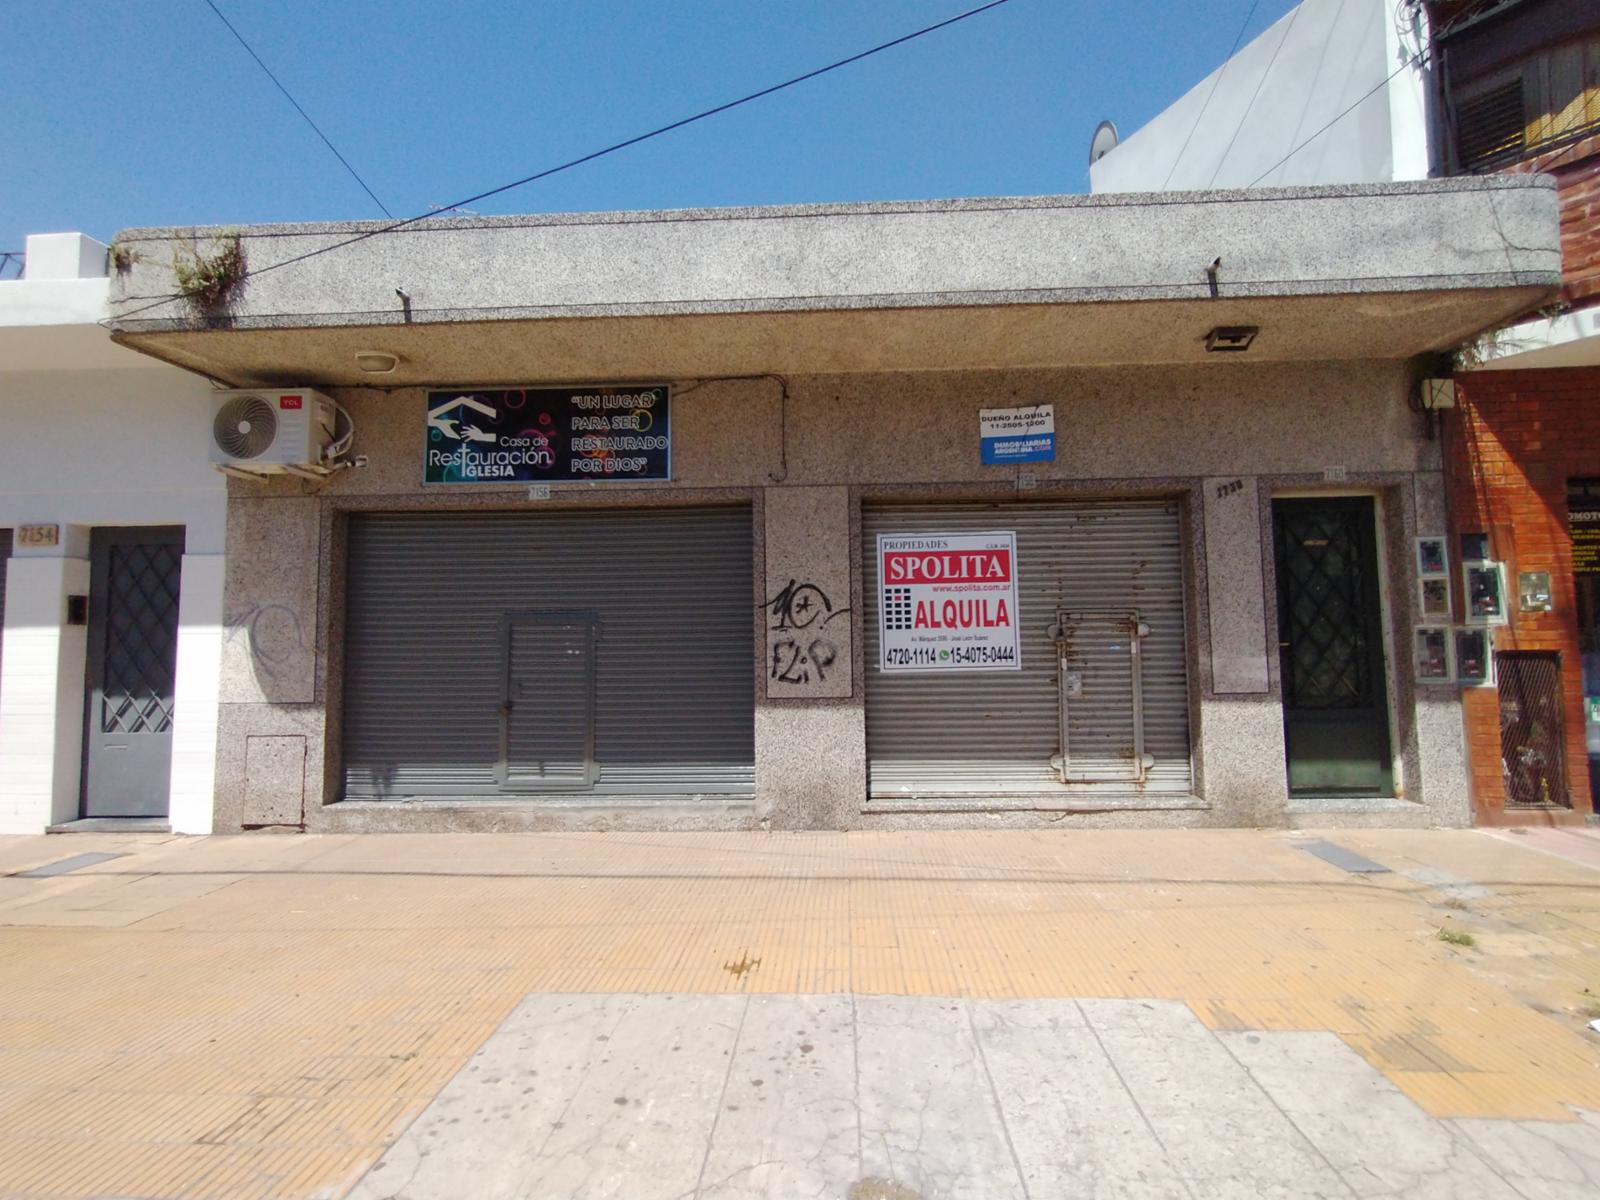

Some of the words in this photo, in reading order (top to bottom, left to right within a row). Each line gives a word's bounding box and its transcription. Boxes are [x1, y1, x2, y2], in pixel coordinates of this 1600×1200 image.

[602, 393, 654, 408] LUGAR
[571, 417, 609, 430] PARA
[612, 415, 640, 429] SER
[1013, 412, 1051, 420] ALQUILA
[500, 436, 530, 448] Casa
[533, 436, 549, 447] de
[571, 435, 669, 451] RESTAURADO
[430, 447, 551, 467] Restauración
[571, 459, 602, 472] POR
[18, 527, 54, 543] 7154
[884, 540, 948, 550] PROPIEDADES
[890, 555, 1005, 580] SPOLITA
[932, 584, 1011, 593] www.spolita.com.ar
[914, 599, 1010, 630] ALQUILA
[887, 648, 936, 665] 4720-1114
[950, 646, 1014, 664] 15-4075-0444
